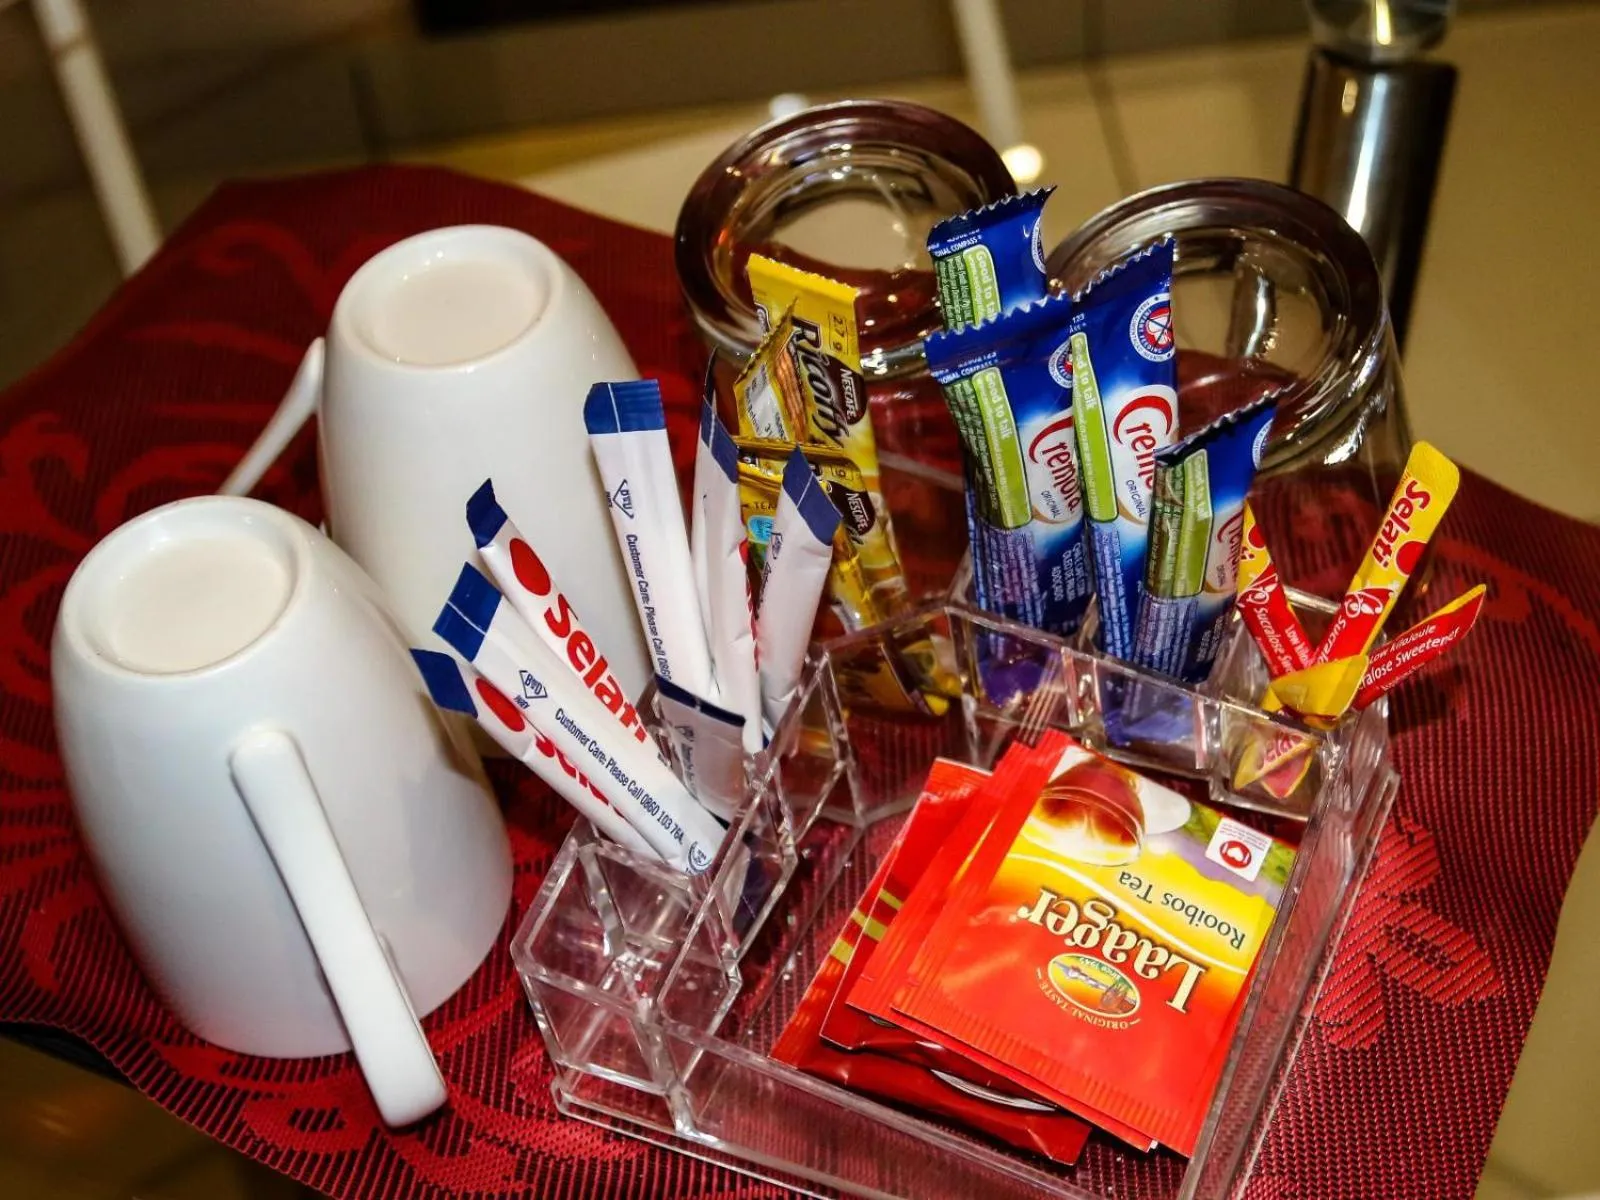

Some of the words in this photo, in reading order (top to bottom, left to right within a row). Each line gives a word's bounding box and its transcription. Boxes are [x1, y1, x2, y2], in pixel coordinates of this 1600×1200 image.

[976, 251, 991, 283] Good
[984, 287, 992, 299] to
[984, 371, 1003, 404] Good
[1079, 371, 1091, 385] to
[994, 404, 1007, 418] to
[1083, 387, 1097, 410] talk
[996, 418, 1014, 440] talk
[1040, 489, 1062, 519] ORIGINAL
[1125, 479, 1147, 517] ORIGINAL
[1372, 479, 1432, 570] Selati
[625, 532, 646, 579] Customer
[643, 604, 661, 637] Please
[1253, 605, 1285, 655] Sucralose
[651, 636, 666, 657] Call
[1391, 627, 1462, 667] Sweetener
[553, 706, 592, 747] Customer
[585, 739, 612, 766] Care:
[603, 757, 633, 788] Please
[625, 779, 646, 801] Call
[638, 793, 662, 818] 0860
[655, 810, 676, 831] 103
[1118, 871, 1155, 904] Tea
[1160, 889, 1247, 950] Rooibos
[1018, 886, 1208, 1013] Laager
[1040, 982, 1069, 1010] TASTE
[1073, 1008, 1129, 1030] ORIGINAL
